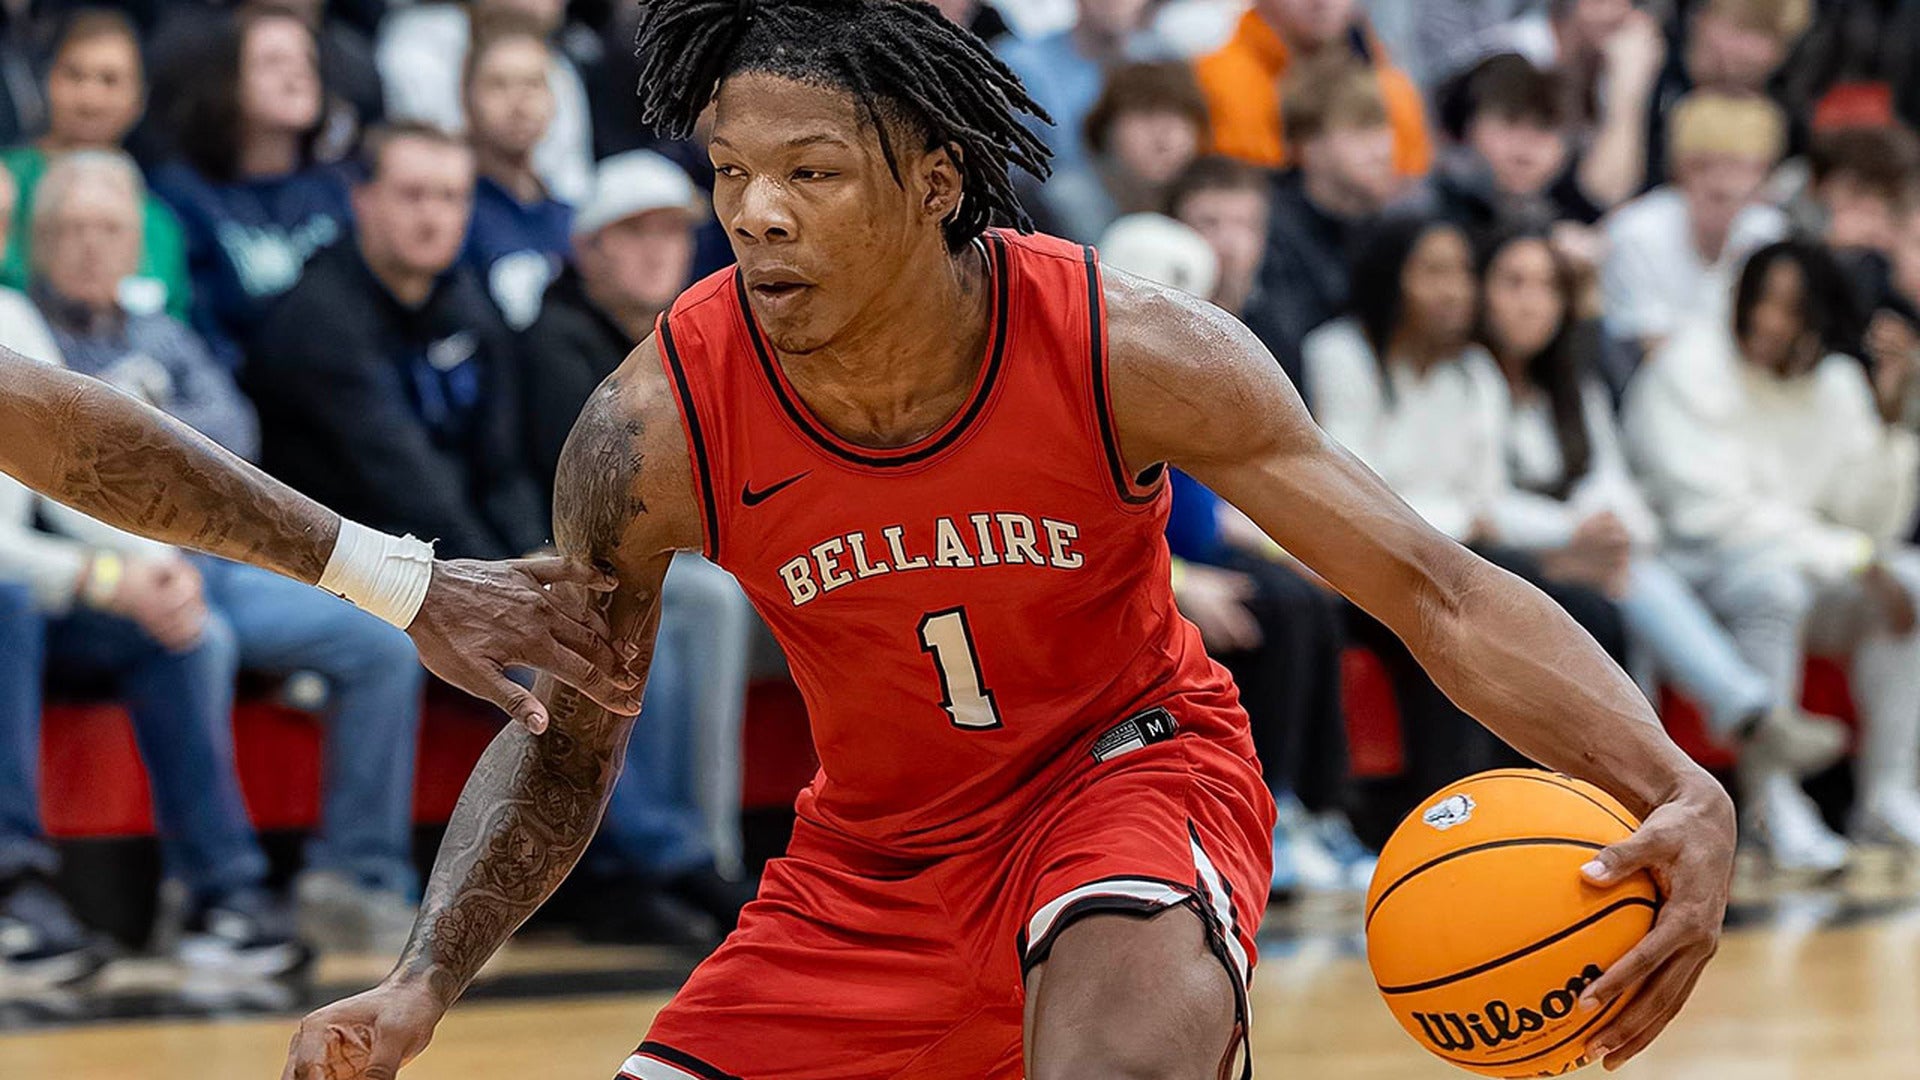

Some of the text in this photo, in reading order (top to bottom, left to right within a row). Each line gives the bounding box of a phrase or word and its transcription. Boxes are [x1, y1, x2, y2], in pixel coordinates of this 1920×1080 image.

[778, 513, 1085, 606] BELLAIRE
[916, 606, 1003, 731] 1
[1146, 719, 1165, 737] M
